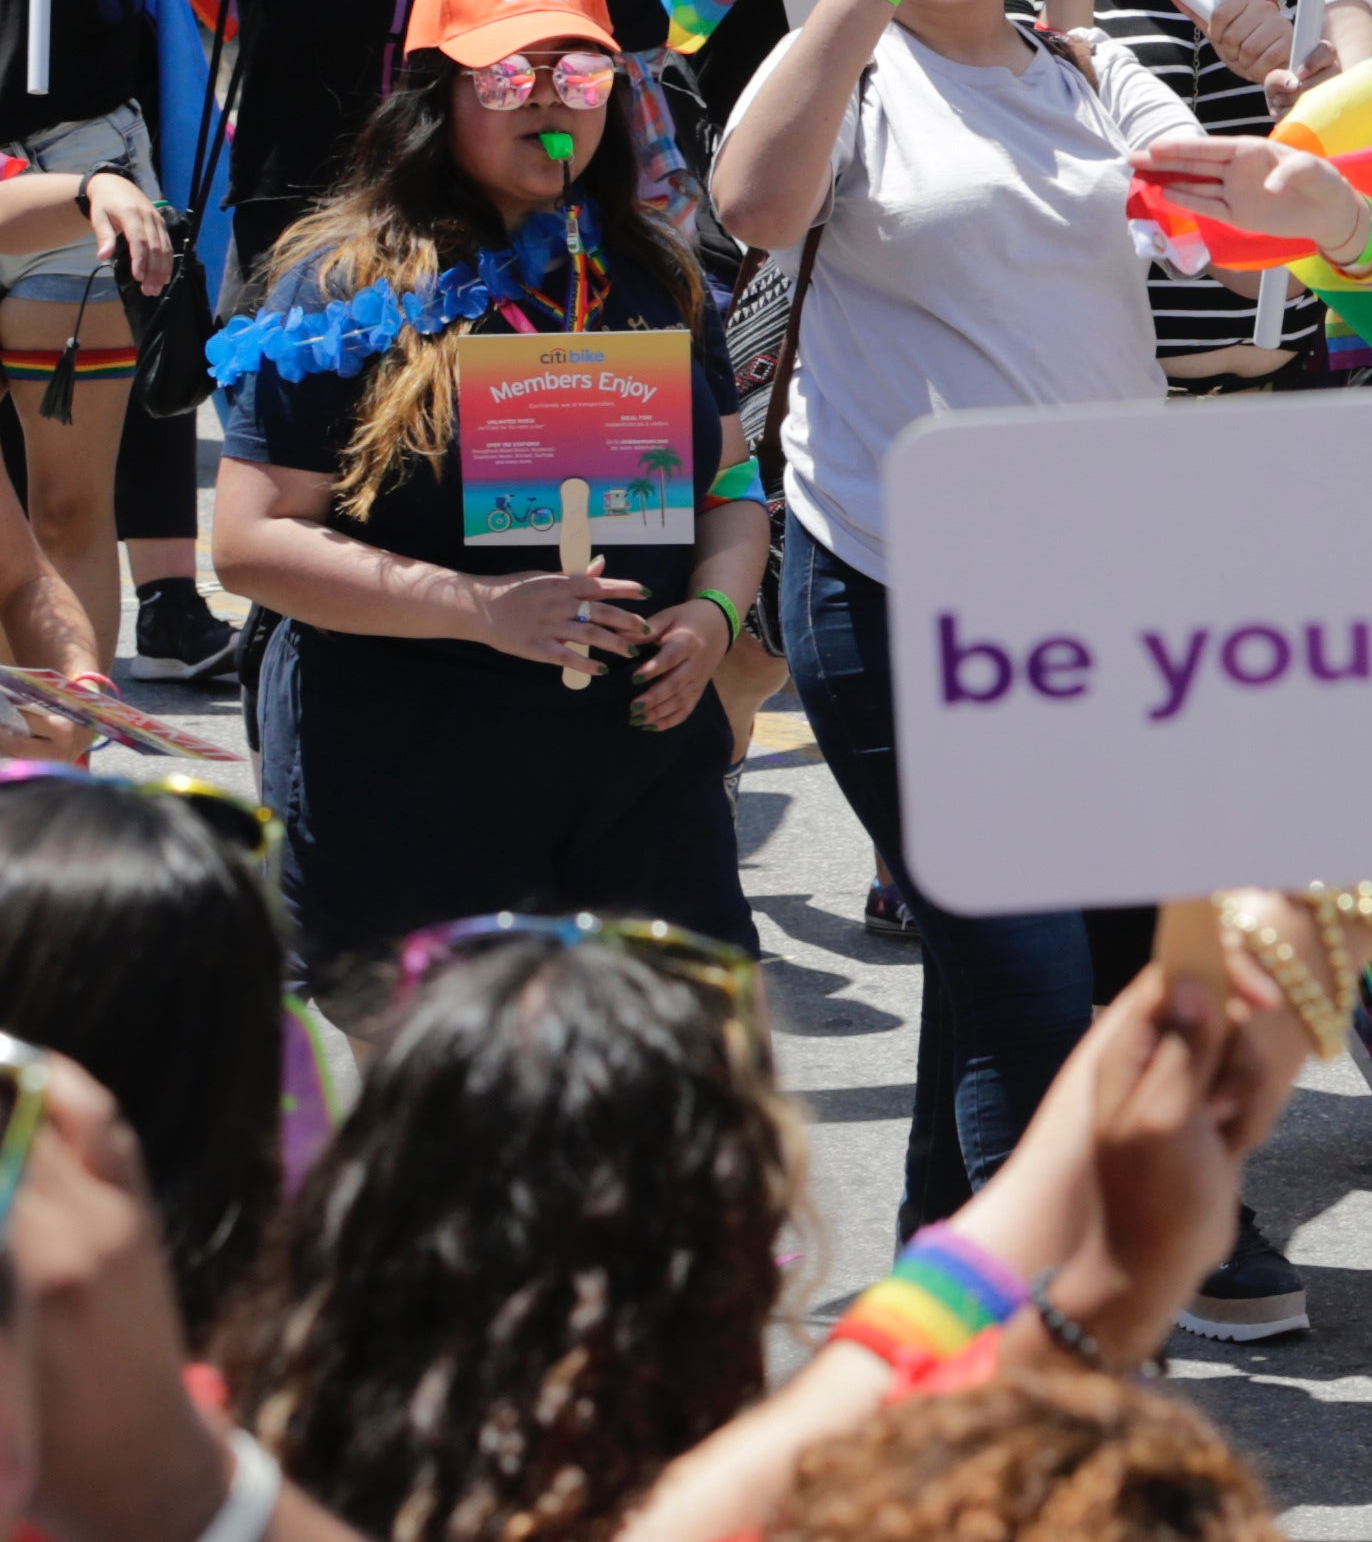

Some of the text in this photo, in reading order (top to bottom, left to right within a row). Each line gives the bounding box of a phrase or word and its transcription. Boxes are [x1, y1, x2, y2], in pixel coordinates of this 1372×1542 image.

[489, 371, 657, 404] Members Enjoy
[935, 609, 1096, 708] be
